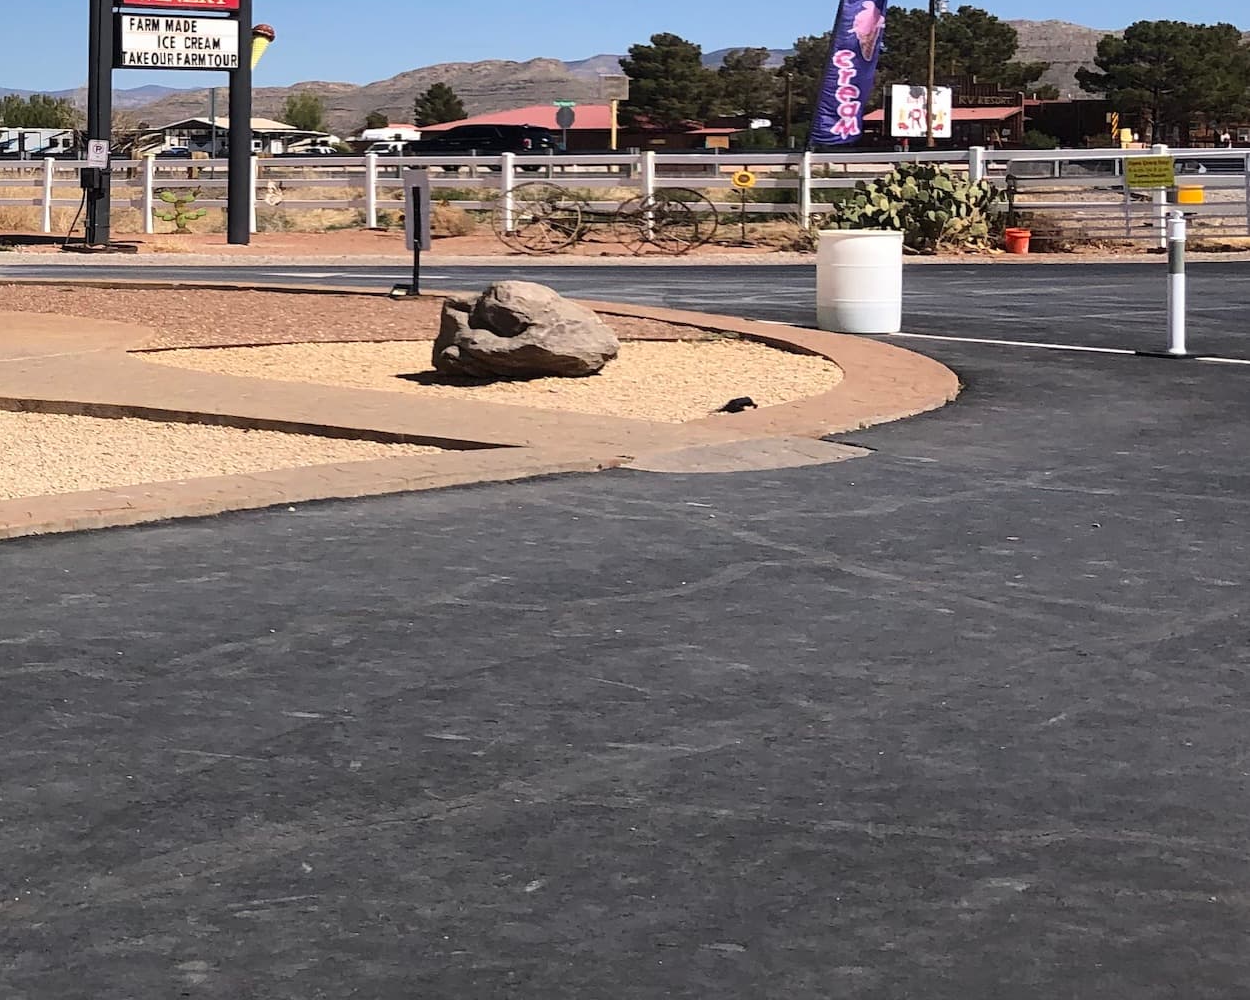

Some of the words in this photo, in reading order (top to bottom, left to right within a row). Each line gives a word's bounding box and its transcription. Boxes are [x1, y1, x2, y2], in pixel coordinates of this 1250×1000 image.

[129, 17, 160, 32] FARM
[165, 19, 198, 33] MADE
[157, 35, 176, 49] ICE
[184, 36, 221, 50] CREAM
[122, 51, 149, 66] TAKE
[151, 52, 174, 66] OUR
[176, 53, 206, 67] FARM
[208, 53, 238, 67] TOUR
[958, 95, 975, 105] RV
